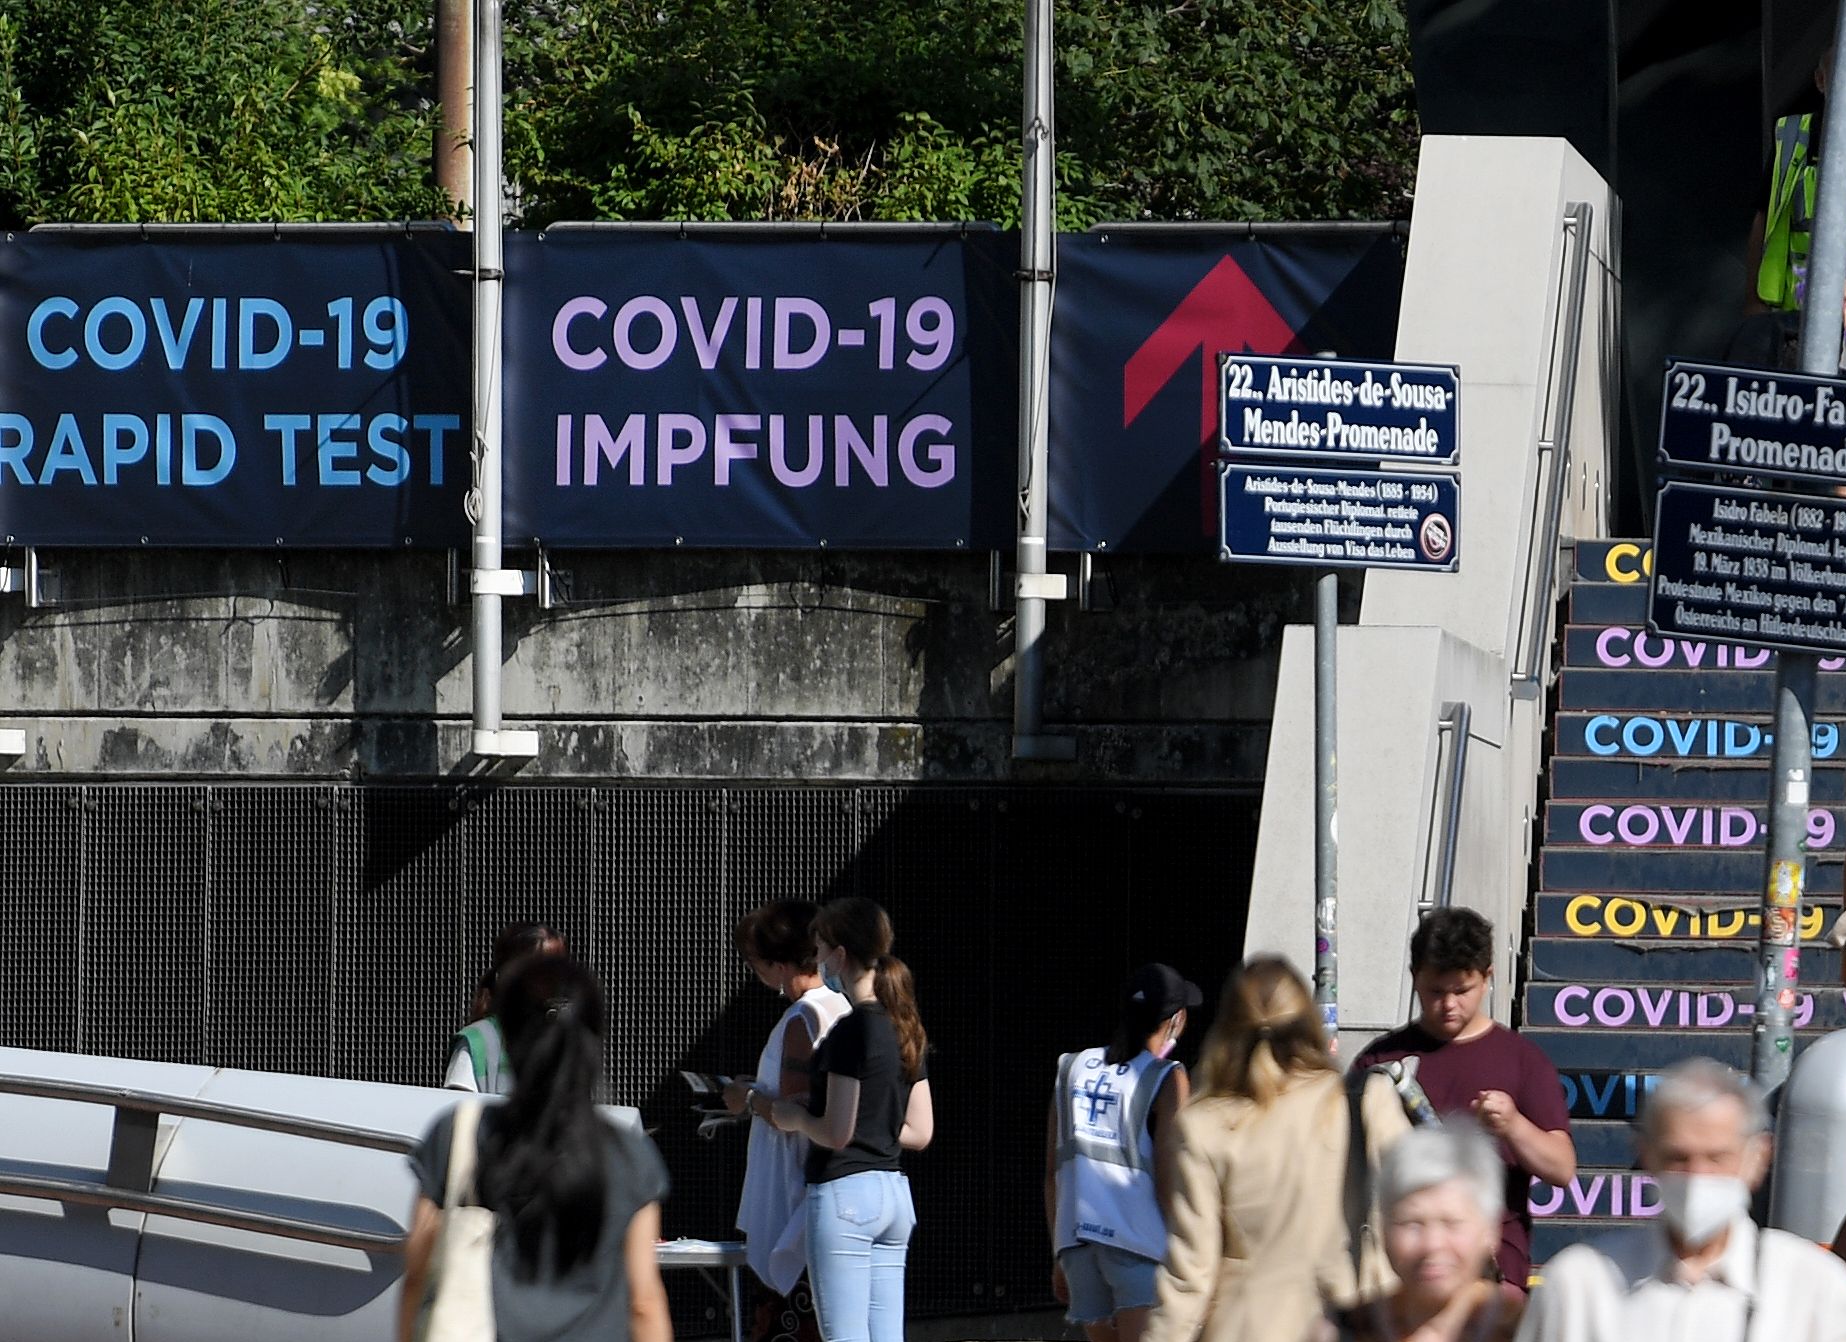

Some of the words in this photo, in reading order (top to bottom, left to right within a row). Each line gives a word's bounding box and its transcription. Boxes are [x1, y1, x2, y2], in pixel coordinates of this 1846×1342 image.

[27, 296, 409, 371] COVID-19
[551, 296, 956, 371] COVID-19
[1267, 366, 1453, 410] Aristides-de-Sousa-
[0, 414, 236, 486] RAPID
[264, 414, 459, 486] TEST
[556, 413, 957, 488] IMPFUNG
[1243, 407, 1438, 453] Mendes-Promenade
[1713, 498, 1747, 521] Isidro
[1749, 502, 1788, 526] Fabela
[1267, 536, 1325, 557] Ausstellung
[1689, 522, 1774, 550] Mexikanischer
[1711, 554, 1740, 577] März
[1771, 561, 1787, 580] im
[1658, 575, 1723, 601] Protestnote
[1724, 582, 1773, 607] Mexikos
[1774, 593, 1810, 613] gegen
[1811, 593, 1837, 613] den
[1675, 601, 1741, 630] Österreichs
[1742, 616, 1757, 631] an
